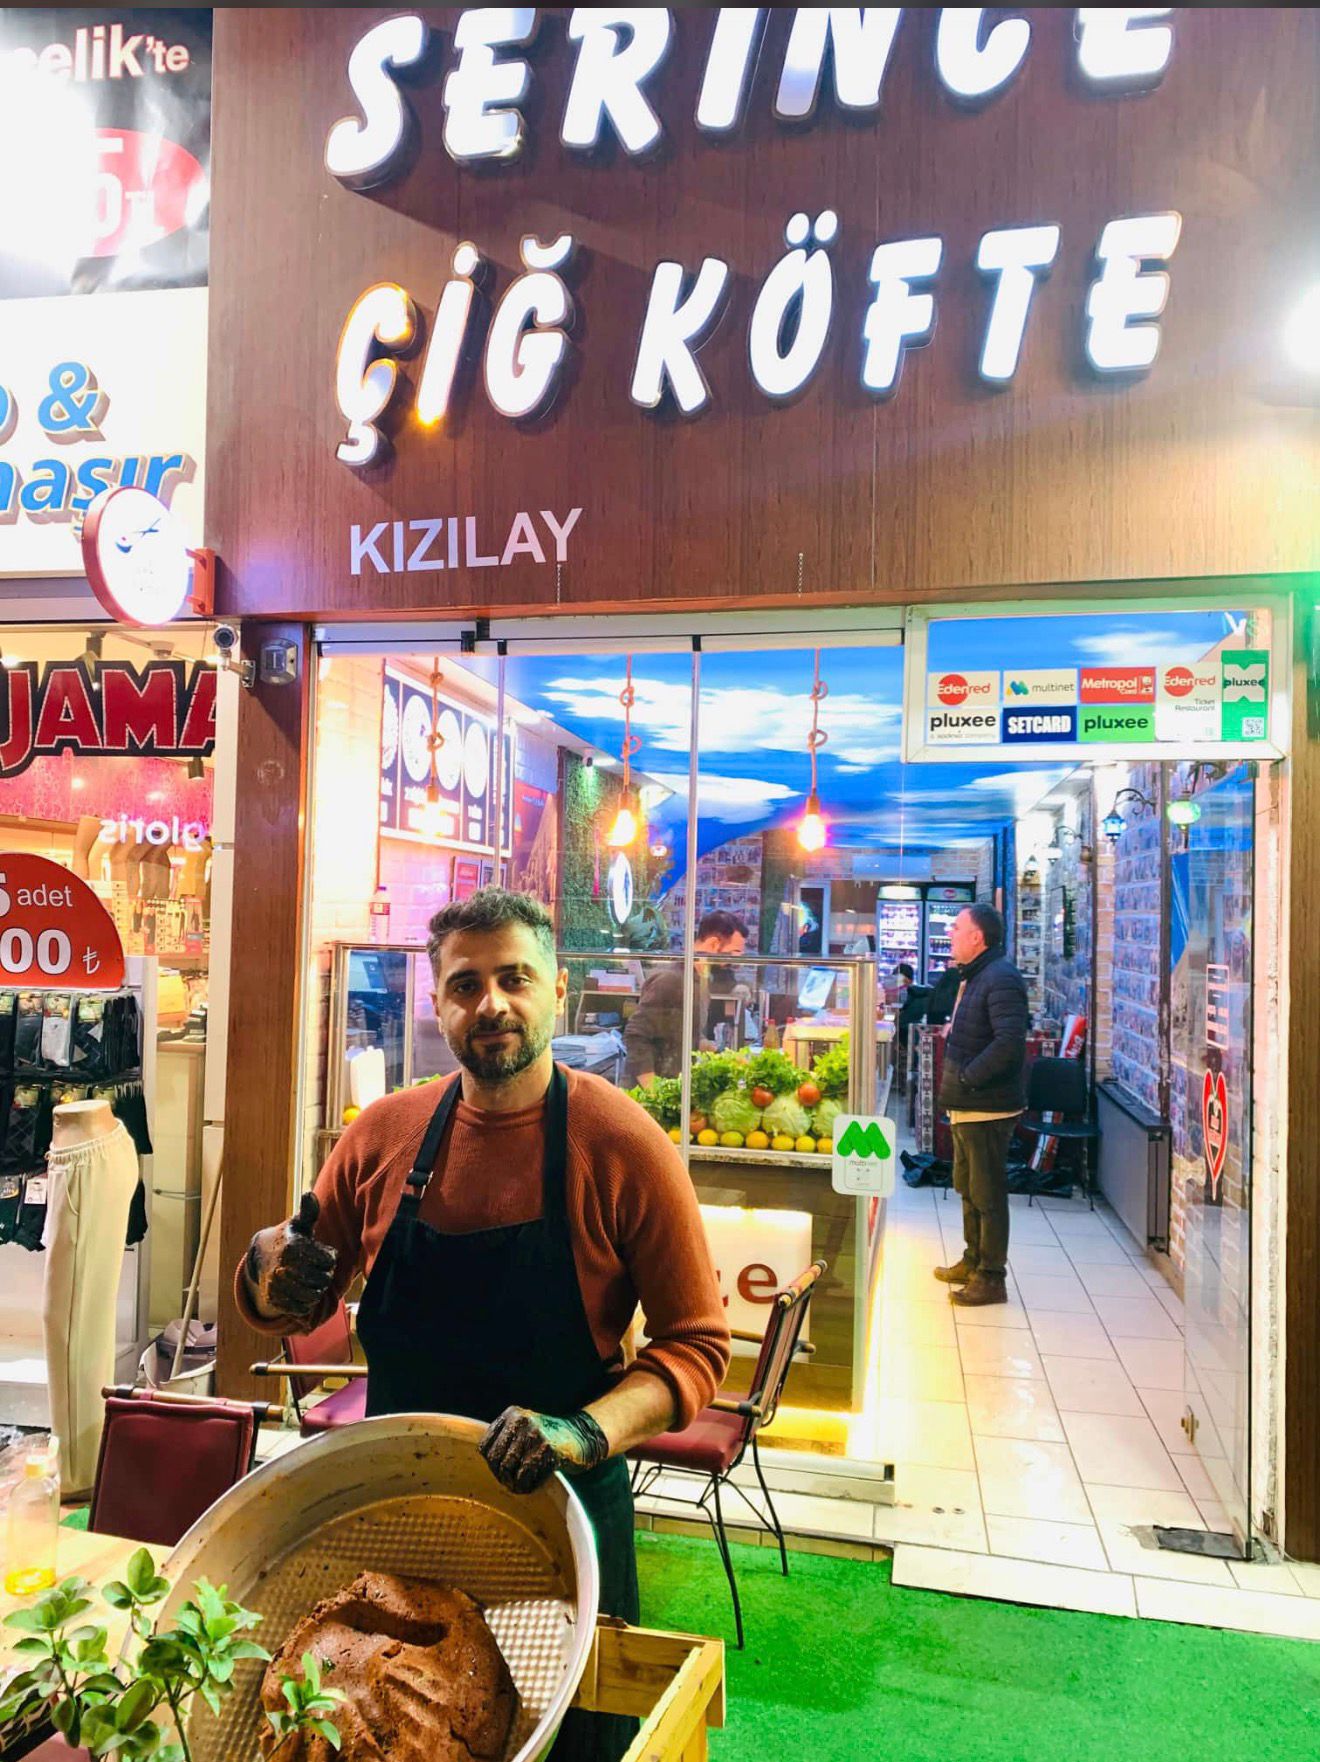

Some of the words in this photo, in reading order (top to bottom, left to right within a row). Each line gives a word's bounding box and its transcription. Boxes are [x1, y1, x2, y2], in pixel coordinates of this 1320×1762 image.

[336, 235, 575, 467] ÇİĞ
[630, 210, 1182, 413] KÖFTE
[37, 361, 101, 434] &
[350, 507, 583, 576] KIZILAY
[1031, 682, 1075, 693] multinet
[1081, 677, 1138, 694] Metropol
[930, 712, 996, 732] pluxee
[1007, 715, 1072, 734] SETCARD
[1084, 715, 1149, 733] pluxee
[17, 883, 73, 907] adet
